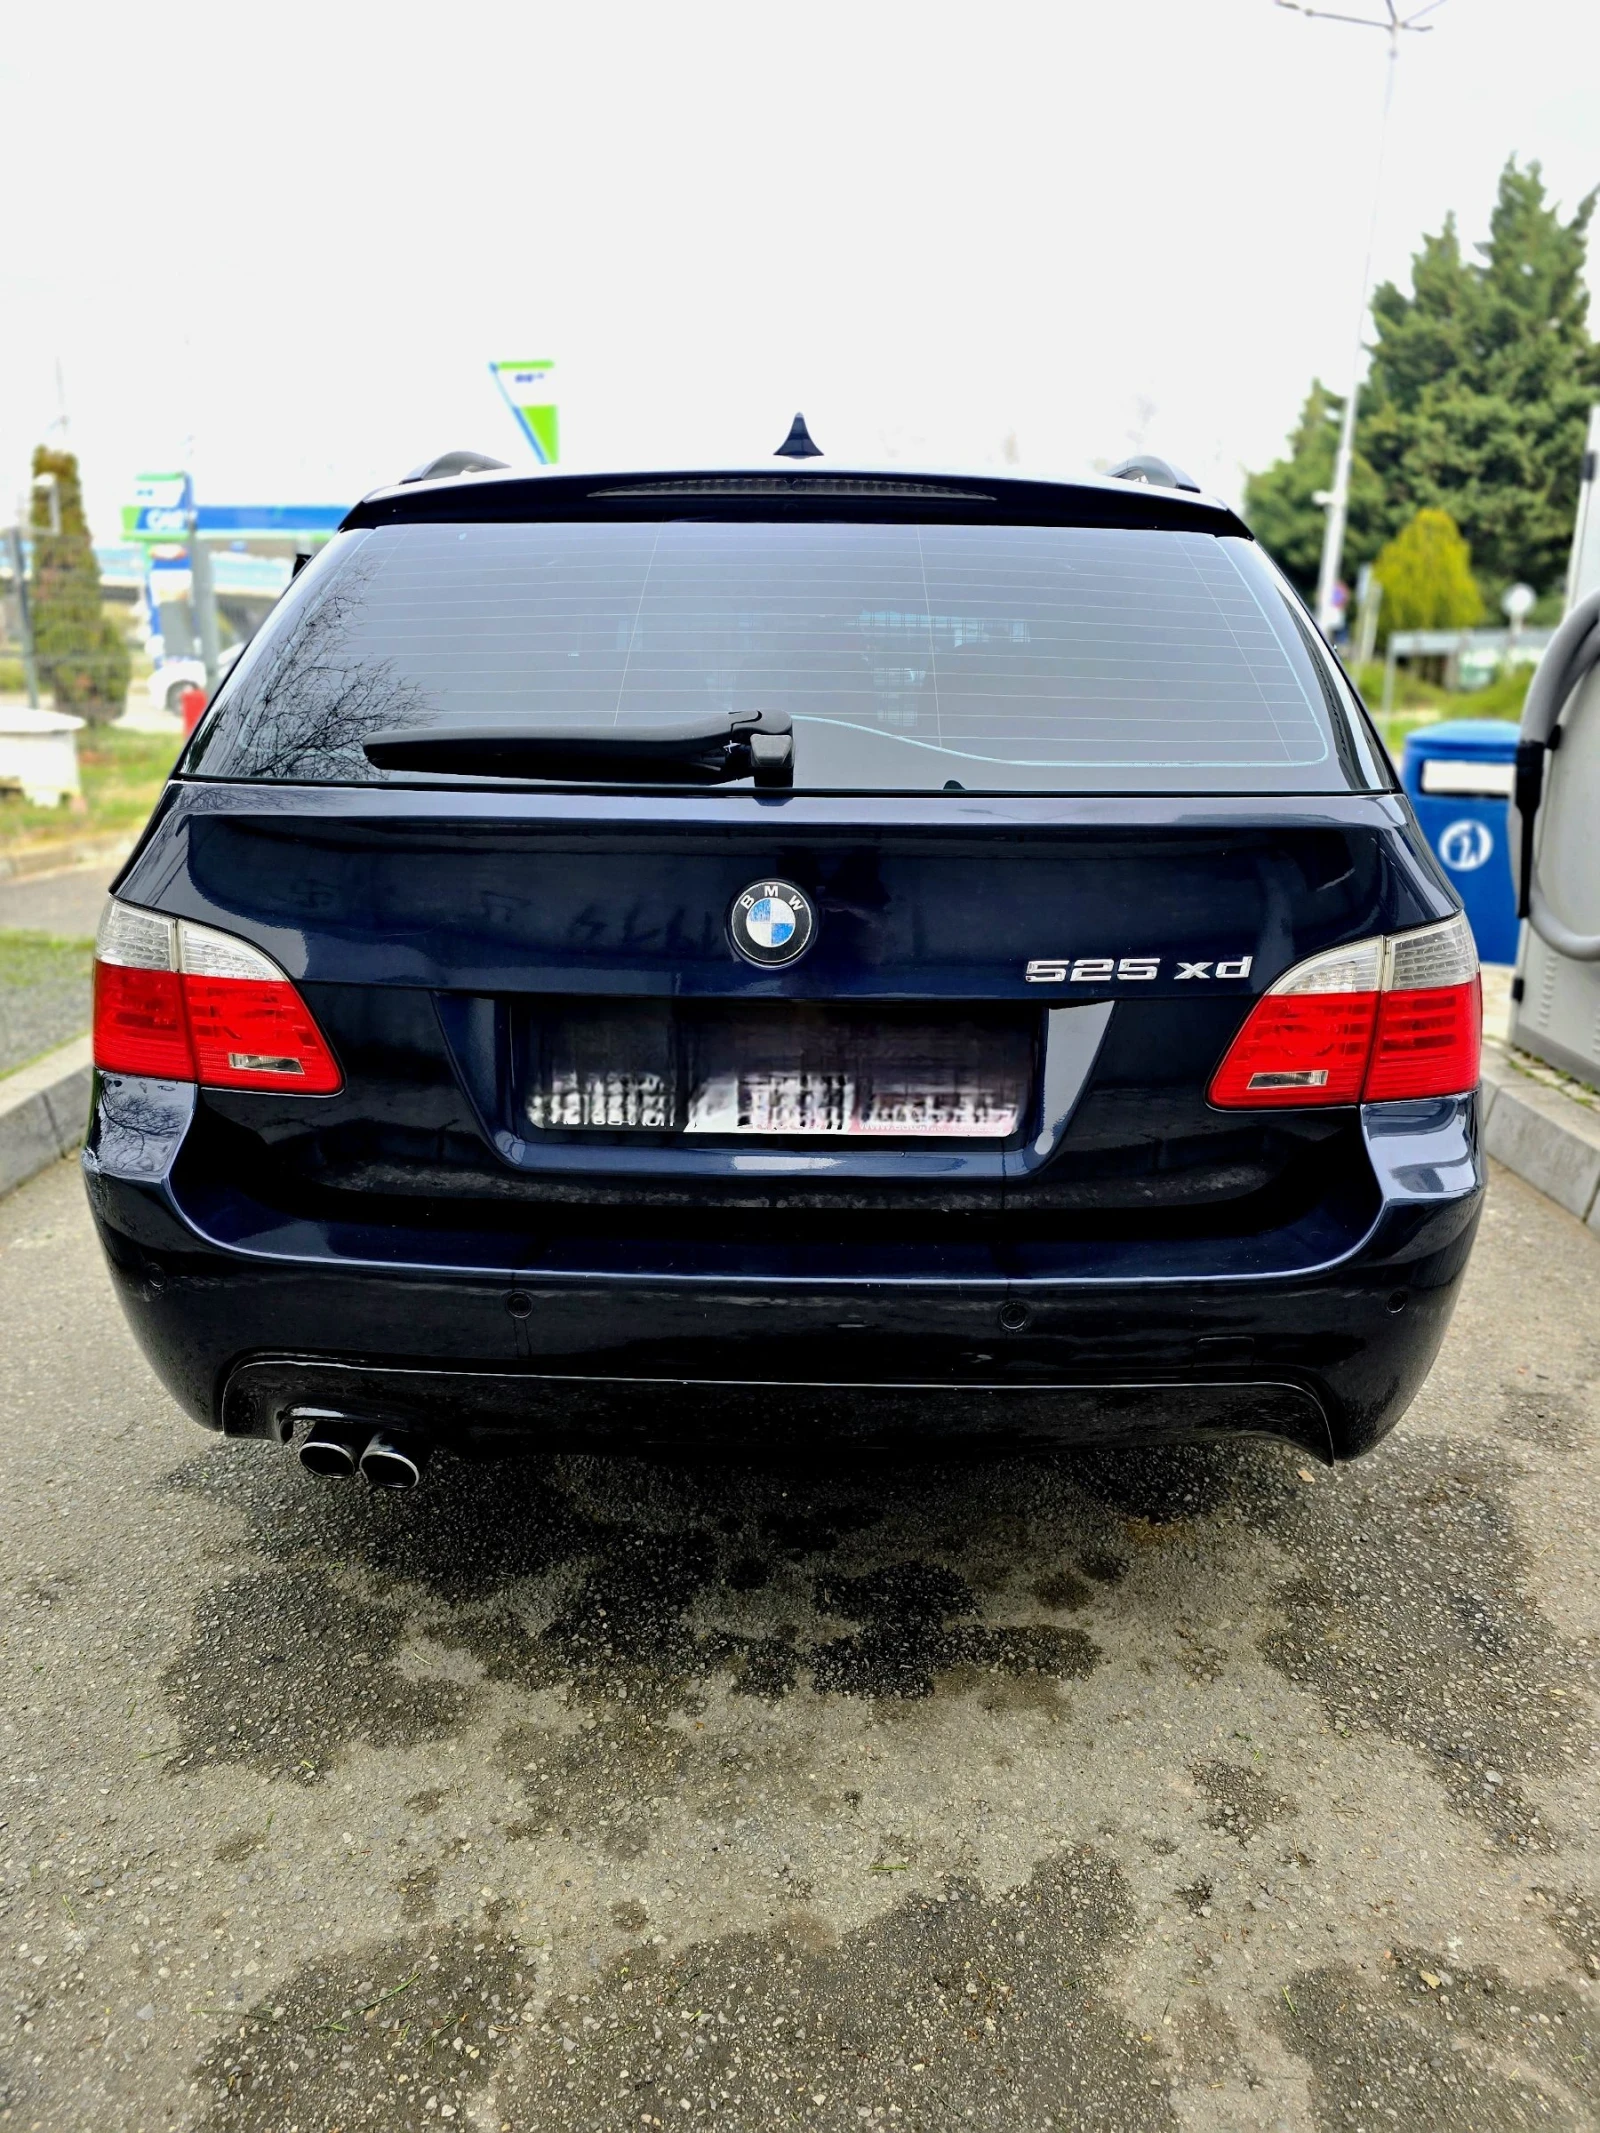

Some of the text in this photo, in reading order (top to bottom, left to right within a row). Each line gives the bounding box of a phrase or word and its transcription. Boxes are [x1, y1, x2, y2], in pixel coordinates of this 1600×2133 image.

[740, 885, 804, 911] BMW
[1025, 956, 1253, 983] 525 xd
